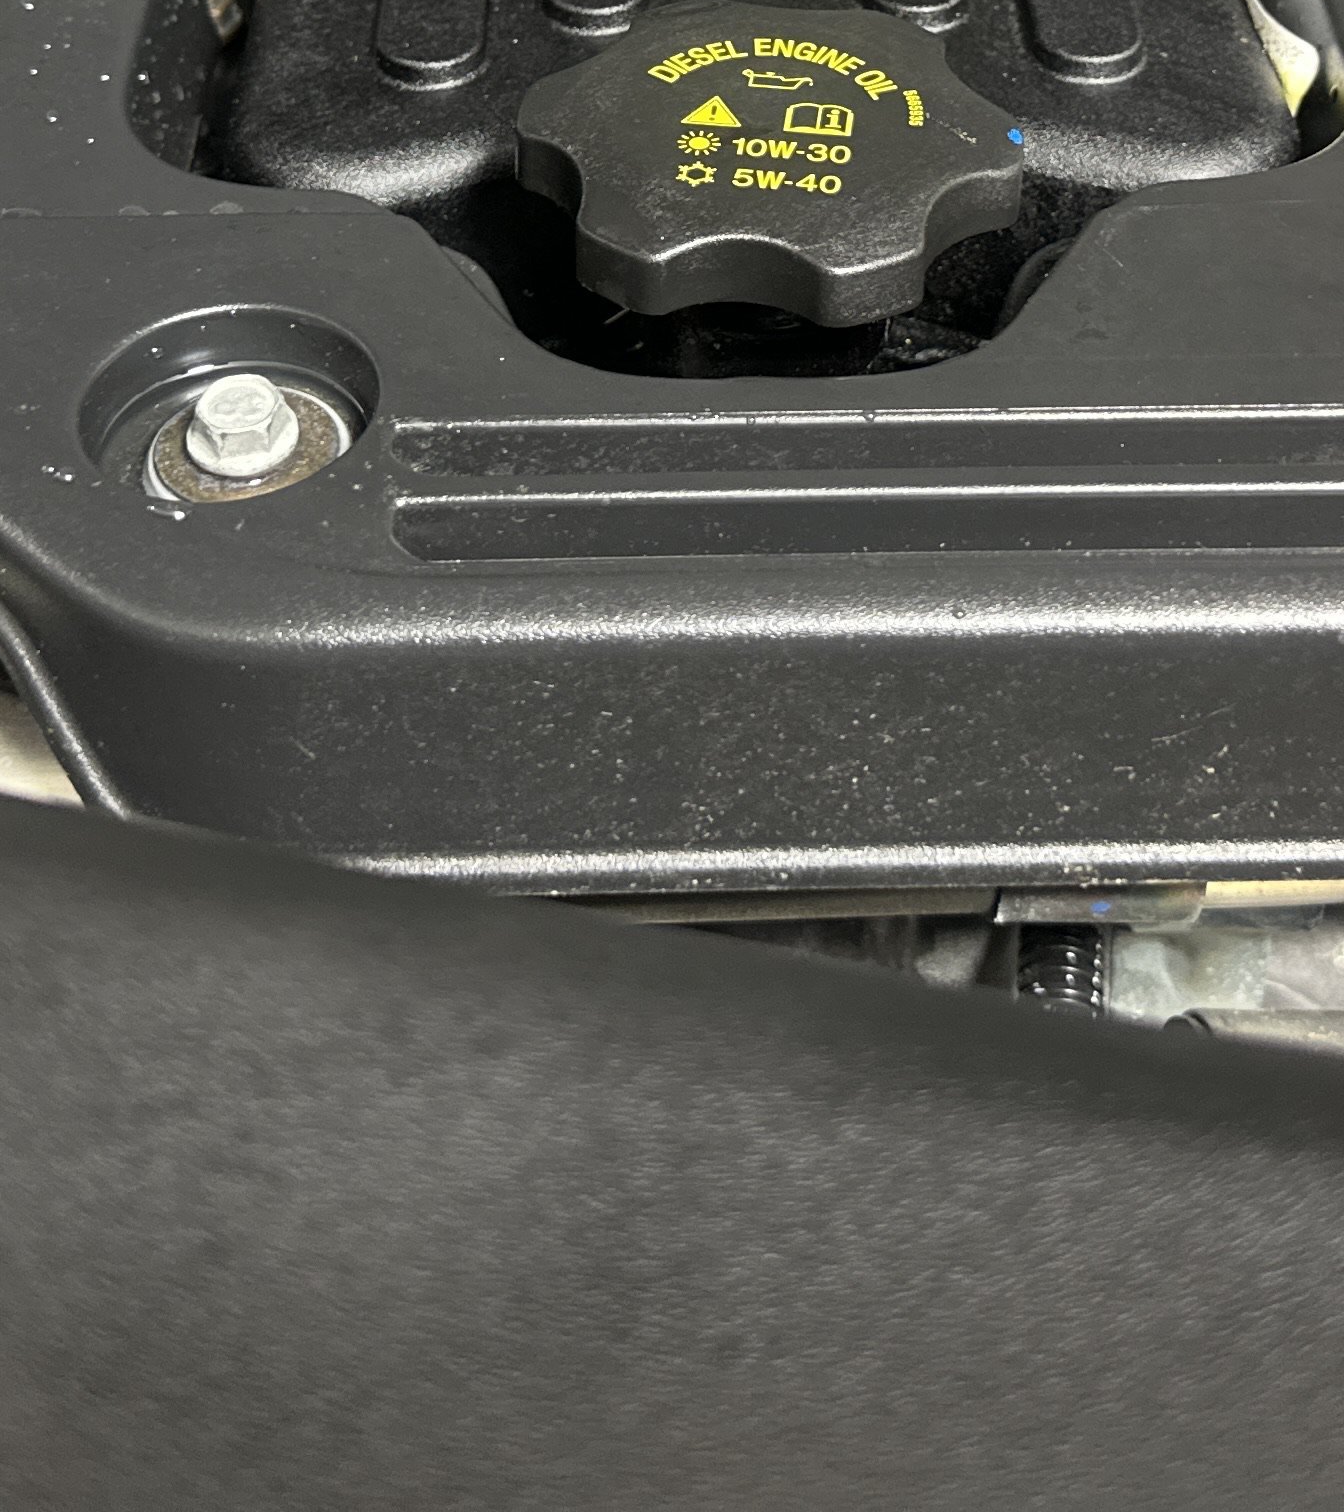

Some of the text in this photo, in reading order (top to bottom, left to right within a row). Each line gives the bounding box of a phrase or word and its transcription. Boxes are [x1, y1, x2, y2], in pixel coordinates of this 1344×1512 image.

[647, 37, 899, 102] DIESEL ENGINE OIL
[732, 137, 852, 164] 10W-30
[731, 168, 842, 194] 5W-40
